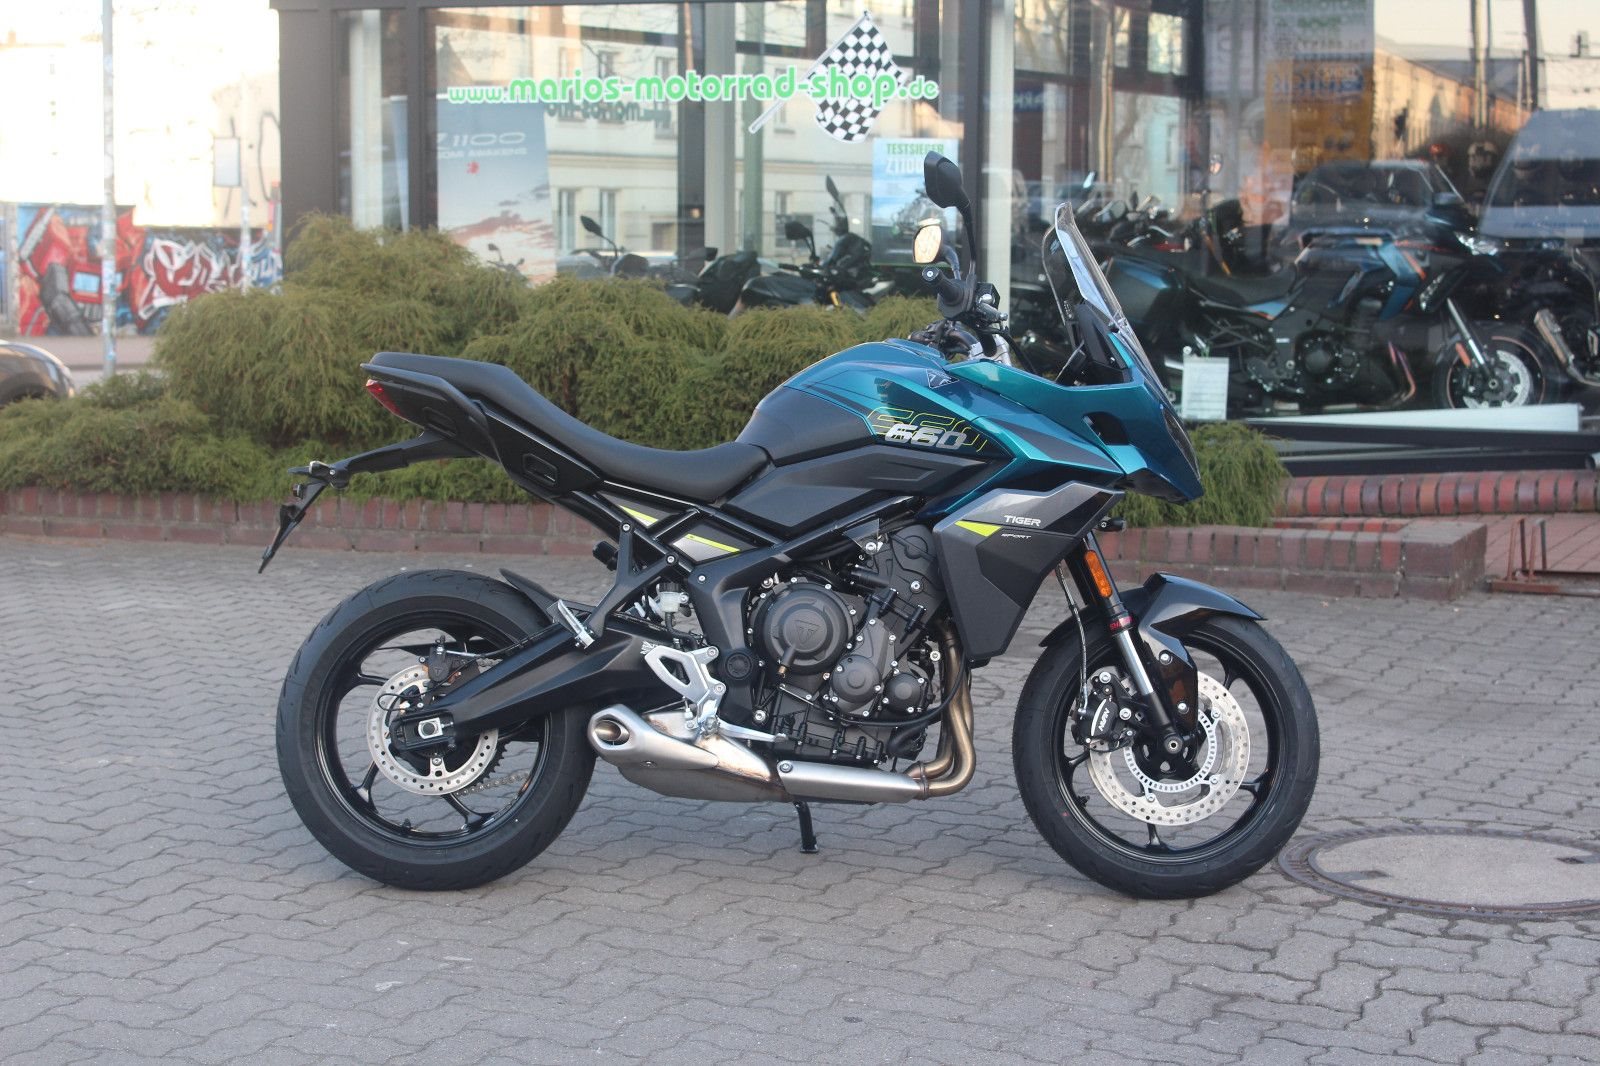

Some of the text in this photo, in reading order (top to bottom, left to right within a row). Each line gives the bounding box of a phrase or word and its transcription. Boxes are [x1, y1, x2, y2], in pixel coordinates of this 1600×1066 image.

[447, 65, 939, 109] www.marios-motorrad-shop.de
[884, 423, 968, 450] 660
[1004, 514, 1042, 527] TIGER
